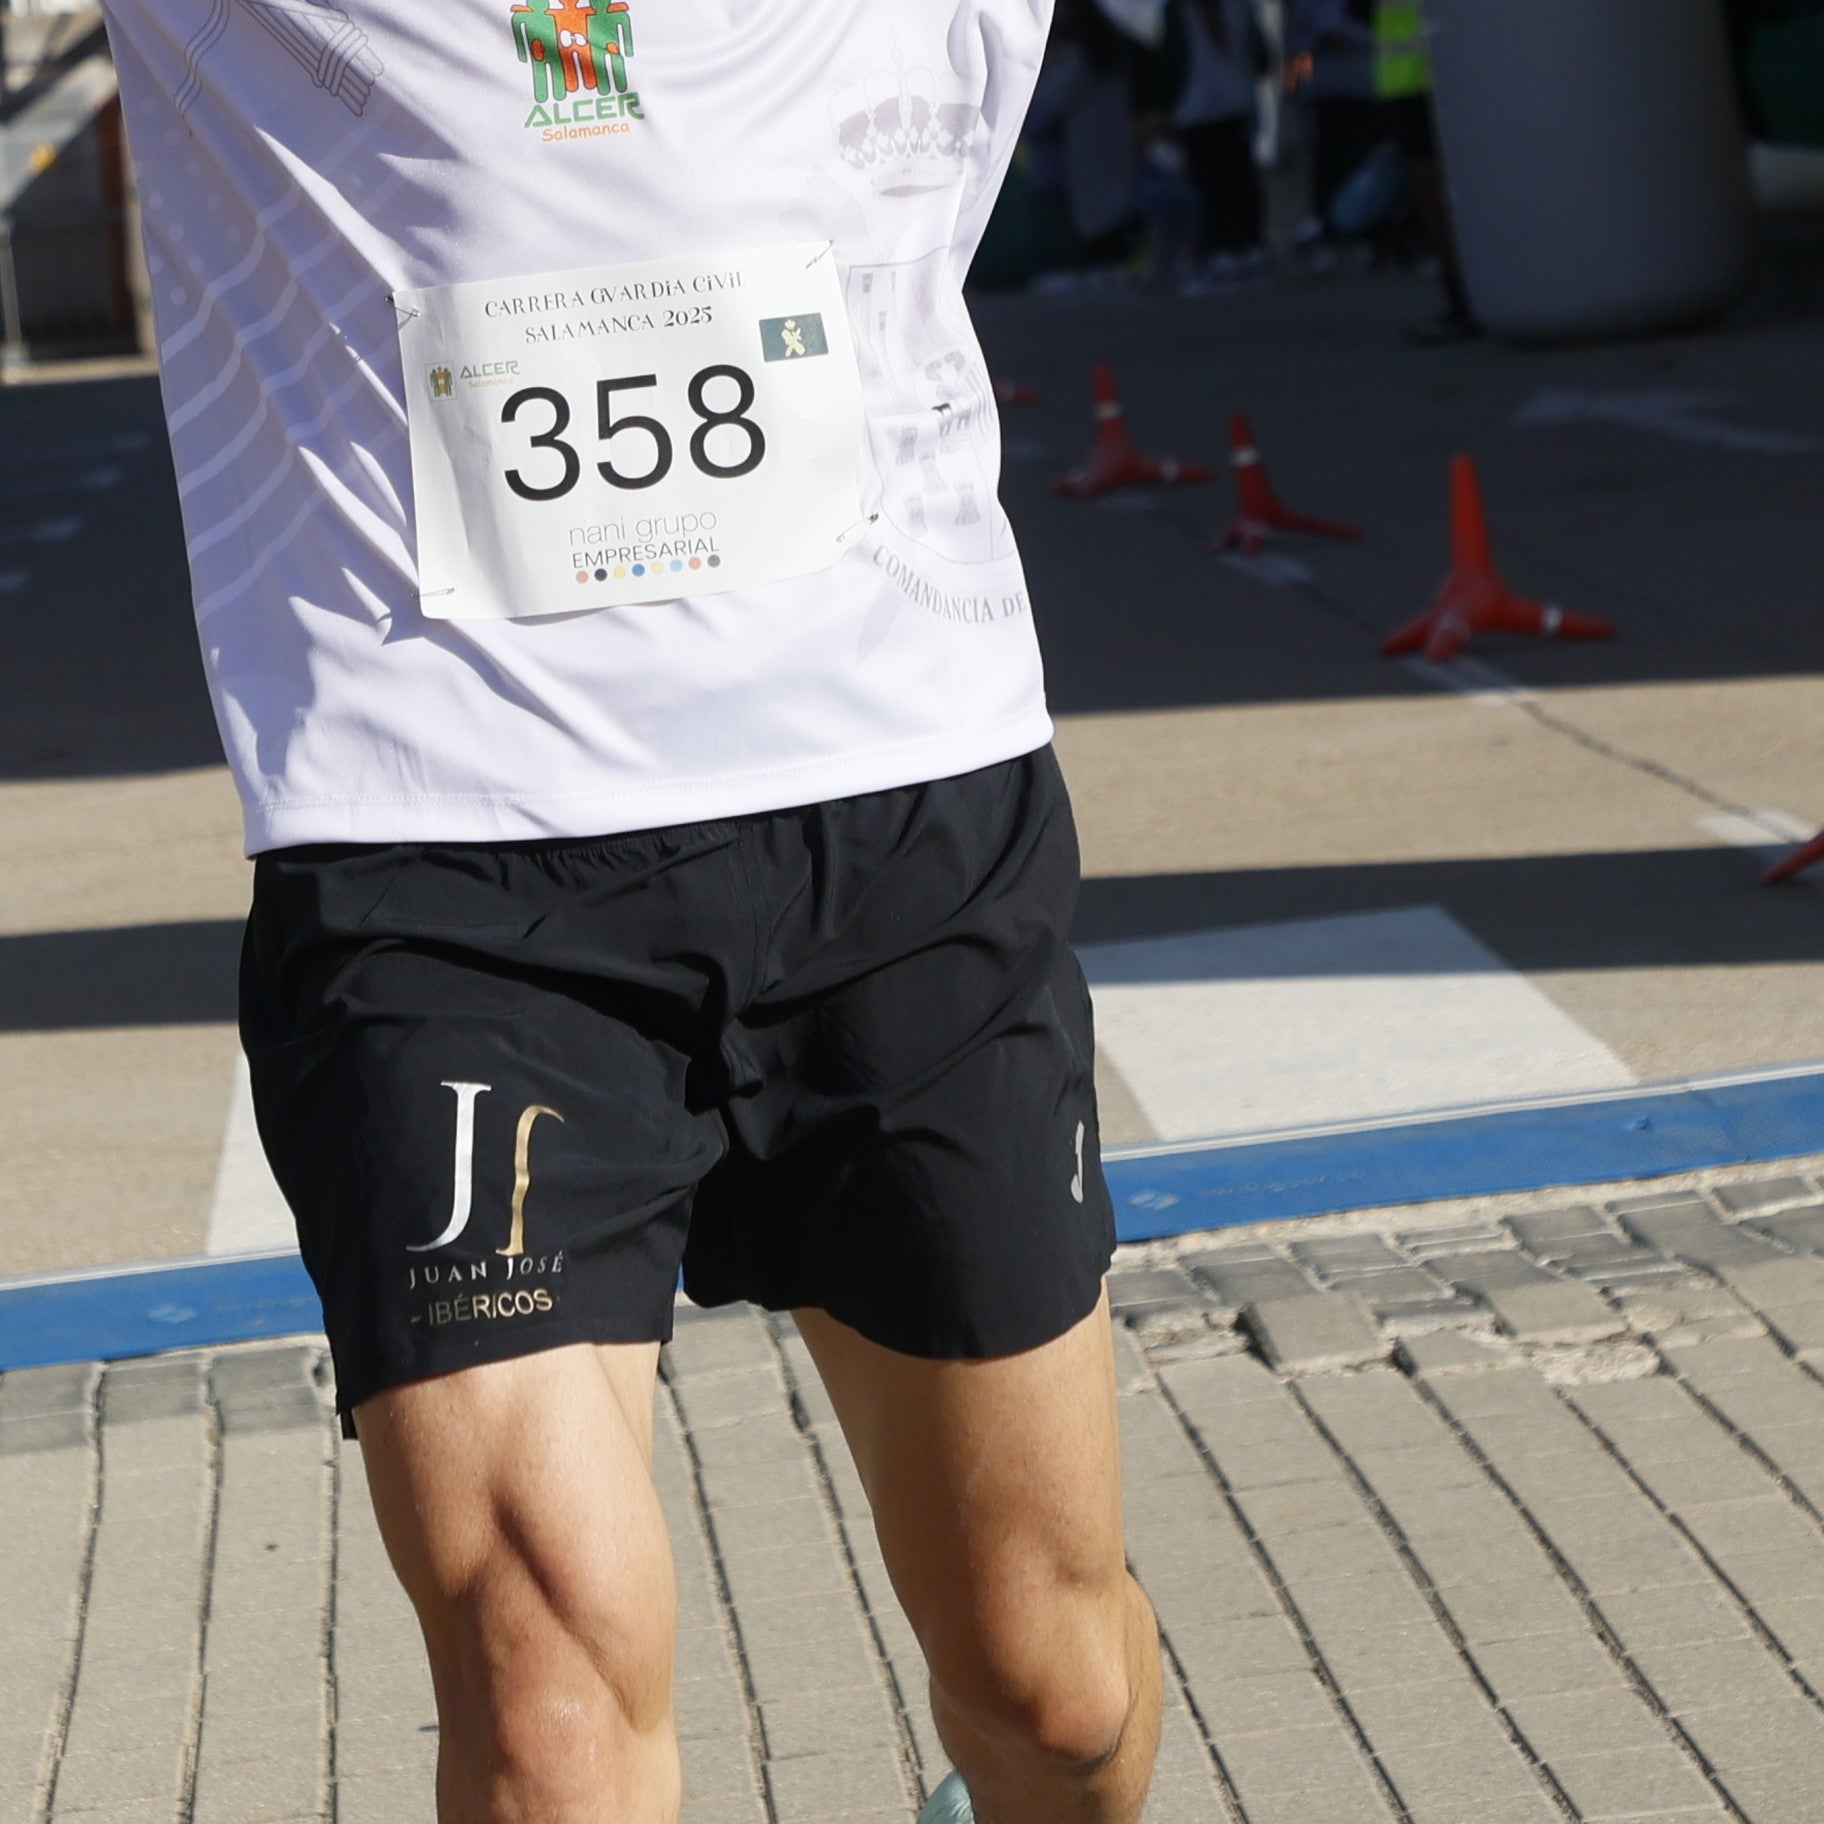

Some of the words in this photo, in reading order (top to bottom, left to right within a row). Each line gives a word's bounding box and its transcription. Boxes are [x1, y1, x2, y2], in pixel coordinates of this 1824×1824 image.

[524, 91, 646, 128] ALCER
[541, 121, 630, 143] Salamanca
[485, 291, 584, 319] CARRERA
[525, 314, 655, 345] SALAMANCA
[662, 305, 713, 328] 2025
[460, 359, 520, 379] ALCER
[500, 364, 766, 502] 358
[569, 515, 625, 546] nani
[635, 511, 717, 544] grupo
[573, 536, 721, 569] EMPRESARIAL
[873, 543, 994, 625] COMANDANCIA
[408, 1260, 488, 1290] JUAN
